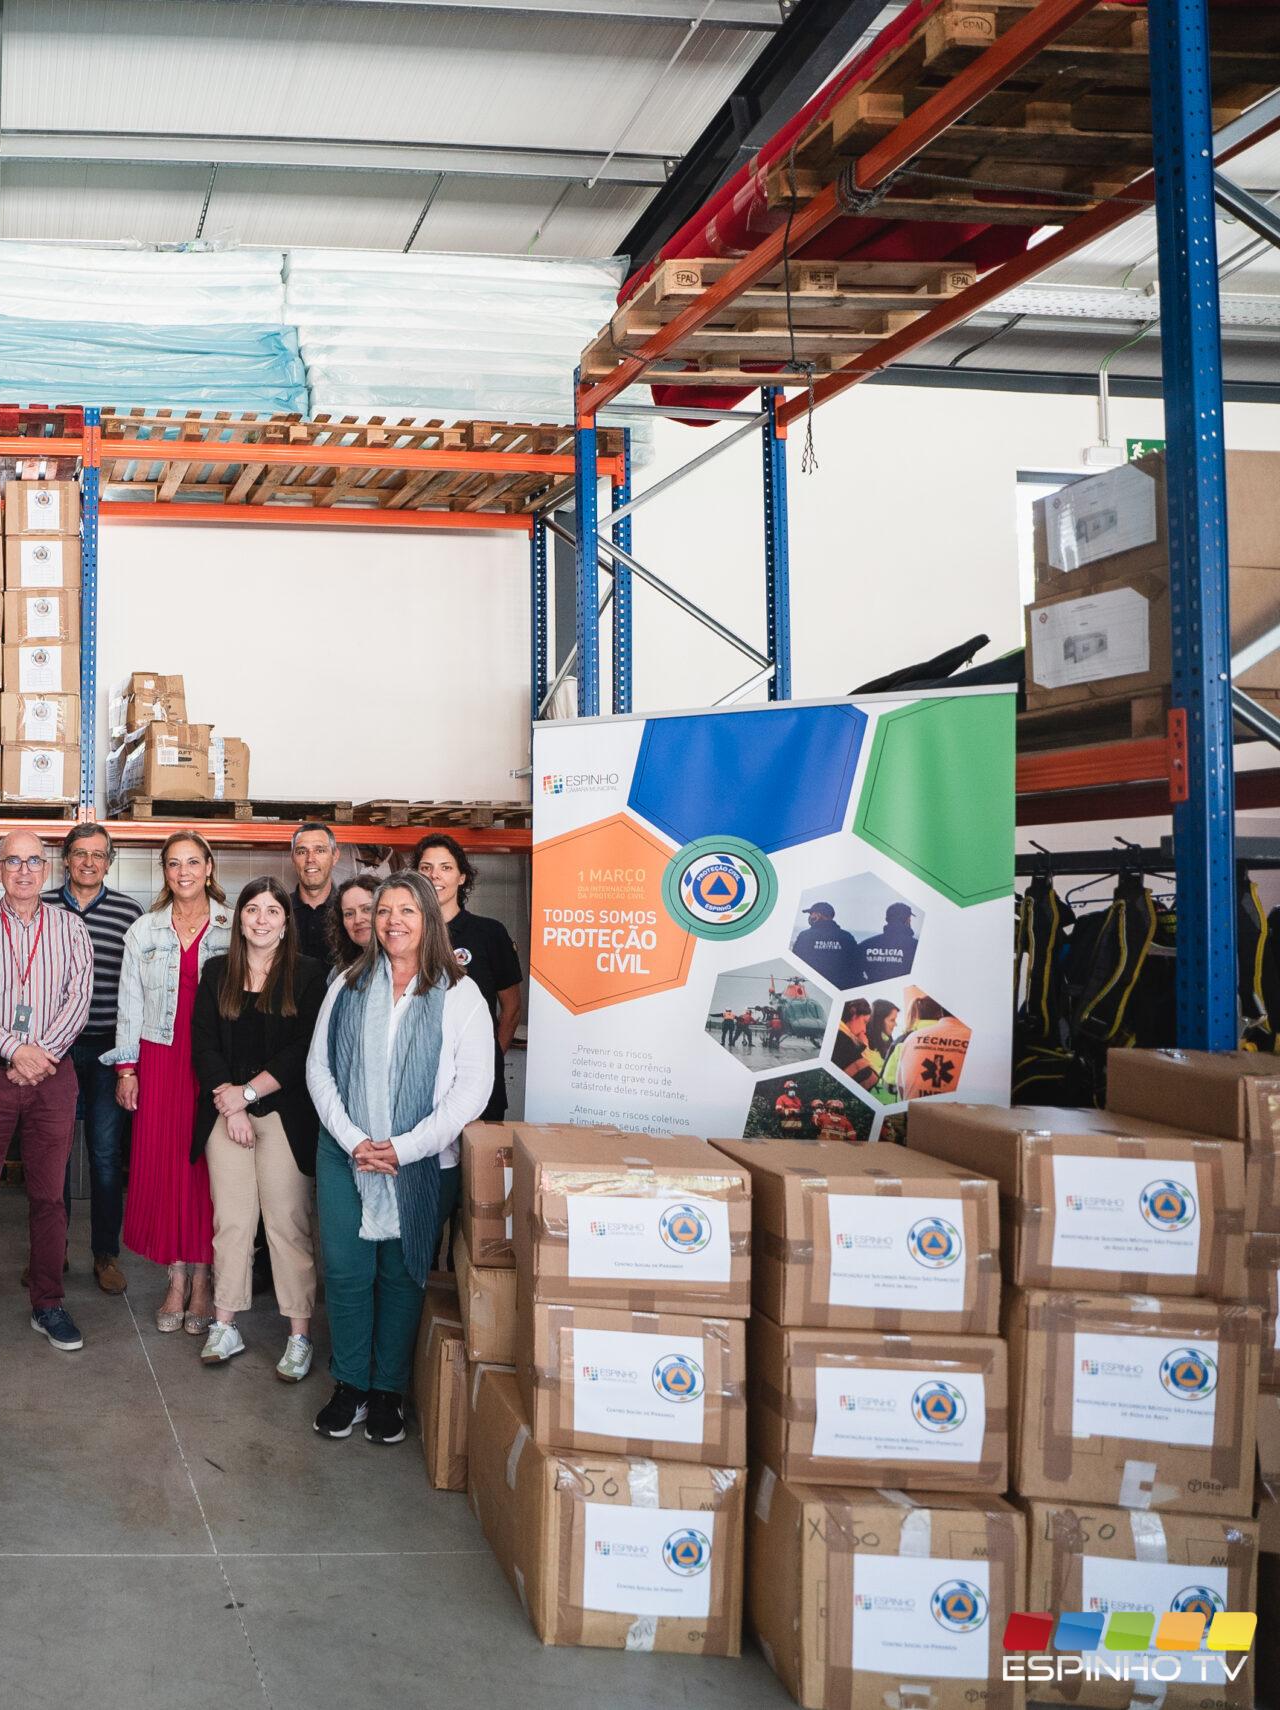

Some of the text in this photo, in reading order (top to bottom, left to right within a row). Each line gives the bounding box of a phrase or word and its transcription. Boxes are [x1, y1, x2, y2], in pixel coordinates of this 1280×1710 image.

[676, 273, 696, 283] EPAL
[951, 276, 970, 286] EPAL
[566, 774, 619, 787] ESPINHO
[578, 869, 646, 885] 1 MARÇO
[696, 865, 741, 882] PROTEÇÃO CIVIL
[589, 892, 626, 901] PROTEÇÃO
[704, 903, 732, 912] ESPINHO
[543, 909, 657, 924] TODOS SOMOS
[543, 925, 657, 953] PROTEÇÃO
[597, 953, 650, 974] CIVIL
[917, 1035, 969, 1049] TÉCNICO
[626, 1050, 653, 1060] riscos
[572, 1058, 607, 1068] coletivos
[625, 1062, 672, 1074] ocorrência
[571, 1070, 582, 1078] de
[583, 1070, 619, 1081] acidente
[621, 1075, 645, 1084] grave
[661, 1078, 672, 1087] de
[571, 1081, 688, 1101] catástrofe deles resultante;
[623, 1111, 649, 1120] riscos
[651, 1113, 690, 1126] coletivos
[619, 1122, 639, 1131] seus
[1084, 1196, 1125, 1207] ESPINHO
[607, 1223, 645, 1232] ESPINHO
[854, 1234, 894, 1246] ESPINHO
[600, 1368, 638, 1380] ESPINHO
[1100, 1362, 1144, 1374] ESPINHO
[857, 1396, 896, 1407] ESPINHO
[612, 1543, 648, 1554] ESPINHO
[873, 1597, 916, 1609] ESPINHO
[1111, 1600, 1154, 1611] ESPINHO
